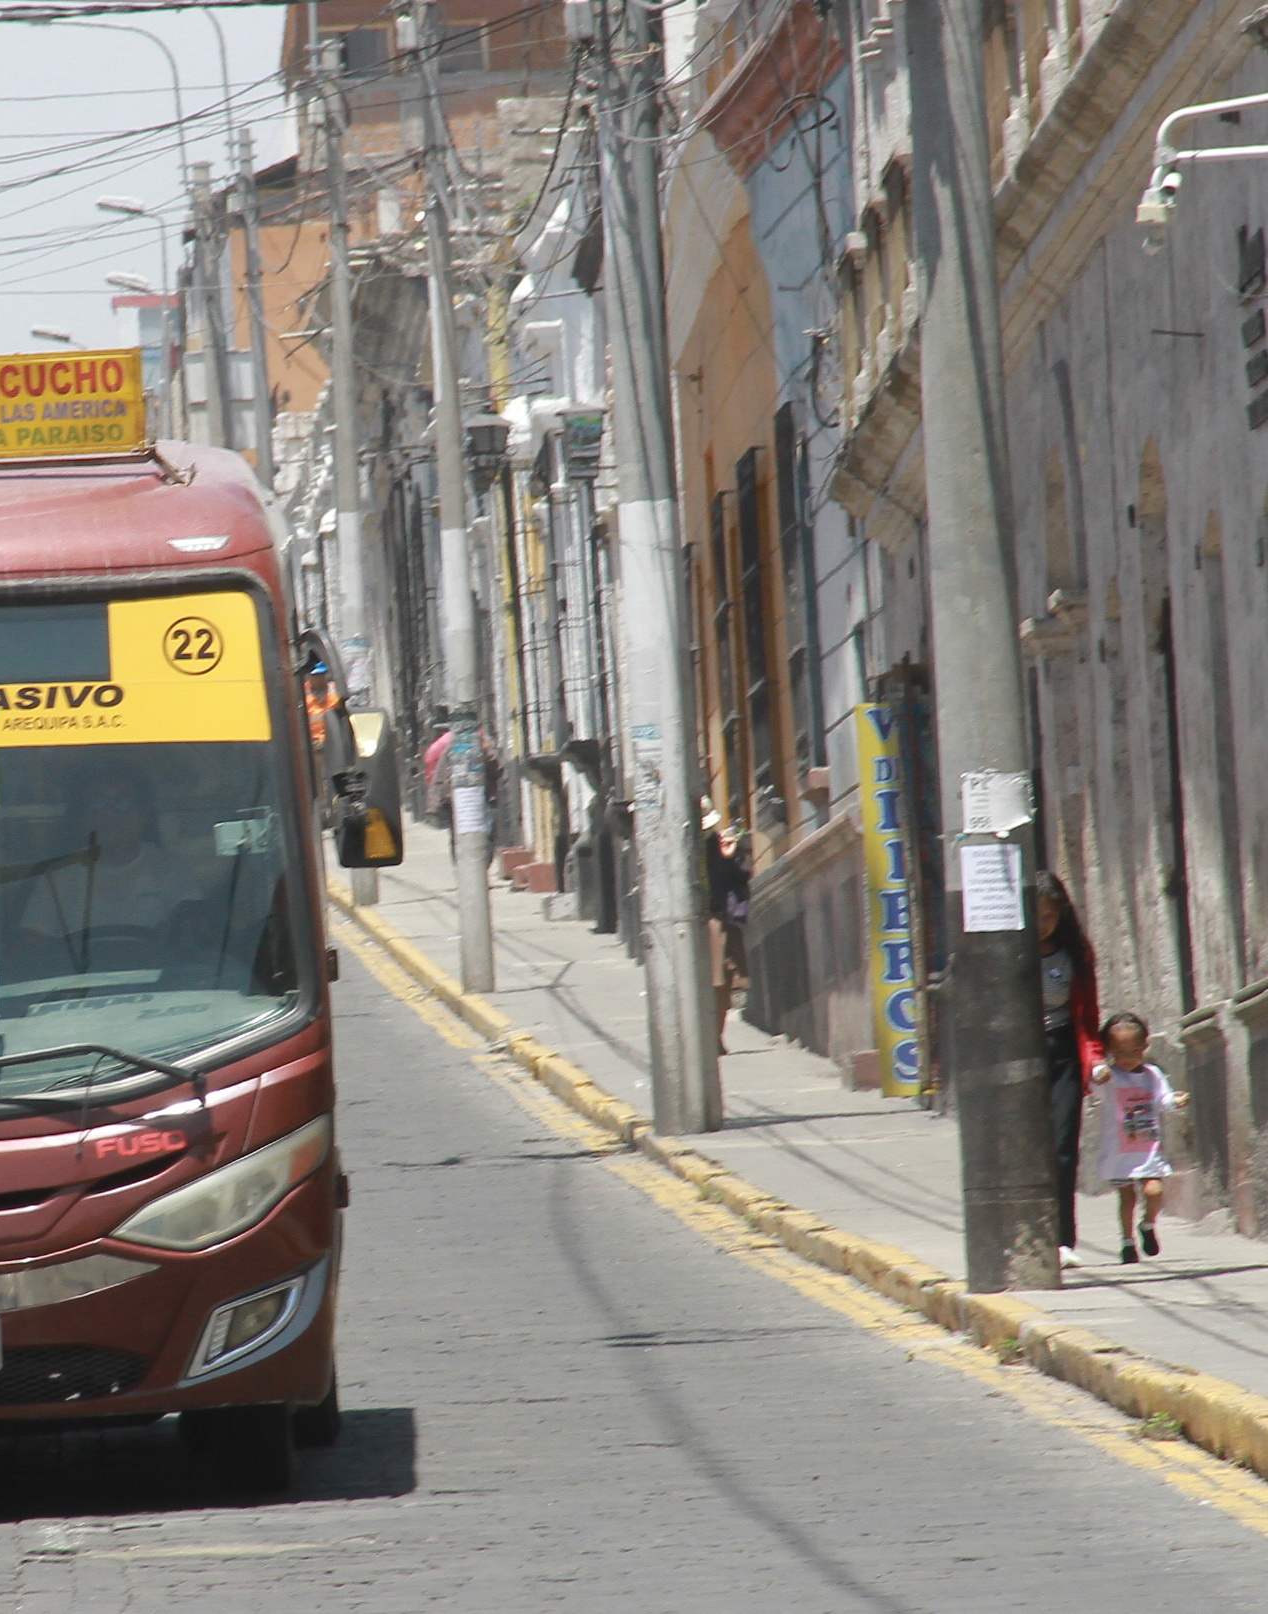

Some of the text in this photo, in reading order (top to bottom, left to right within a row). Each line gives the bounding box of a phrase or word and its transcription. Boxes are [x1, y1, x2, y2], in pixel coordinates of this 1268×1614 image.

[1, 403, 36, 423] LAS
[41, 399, 127, 421] AMERICA
[16, 423, 125, 446] PARAISO
[173, 628, 216, 661] 22
[1, 714, 127, 731] AREQUIPA S.A.C.
[95, 1130, 188, 1159] FUSO
